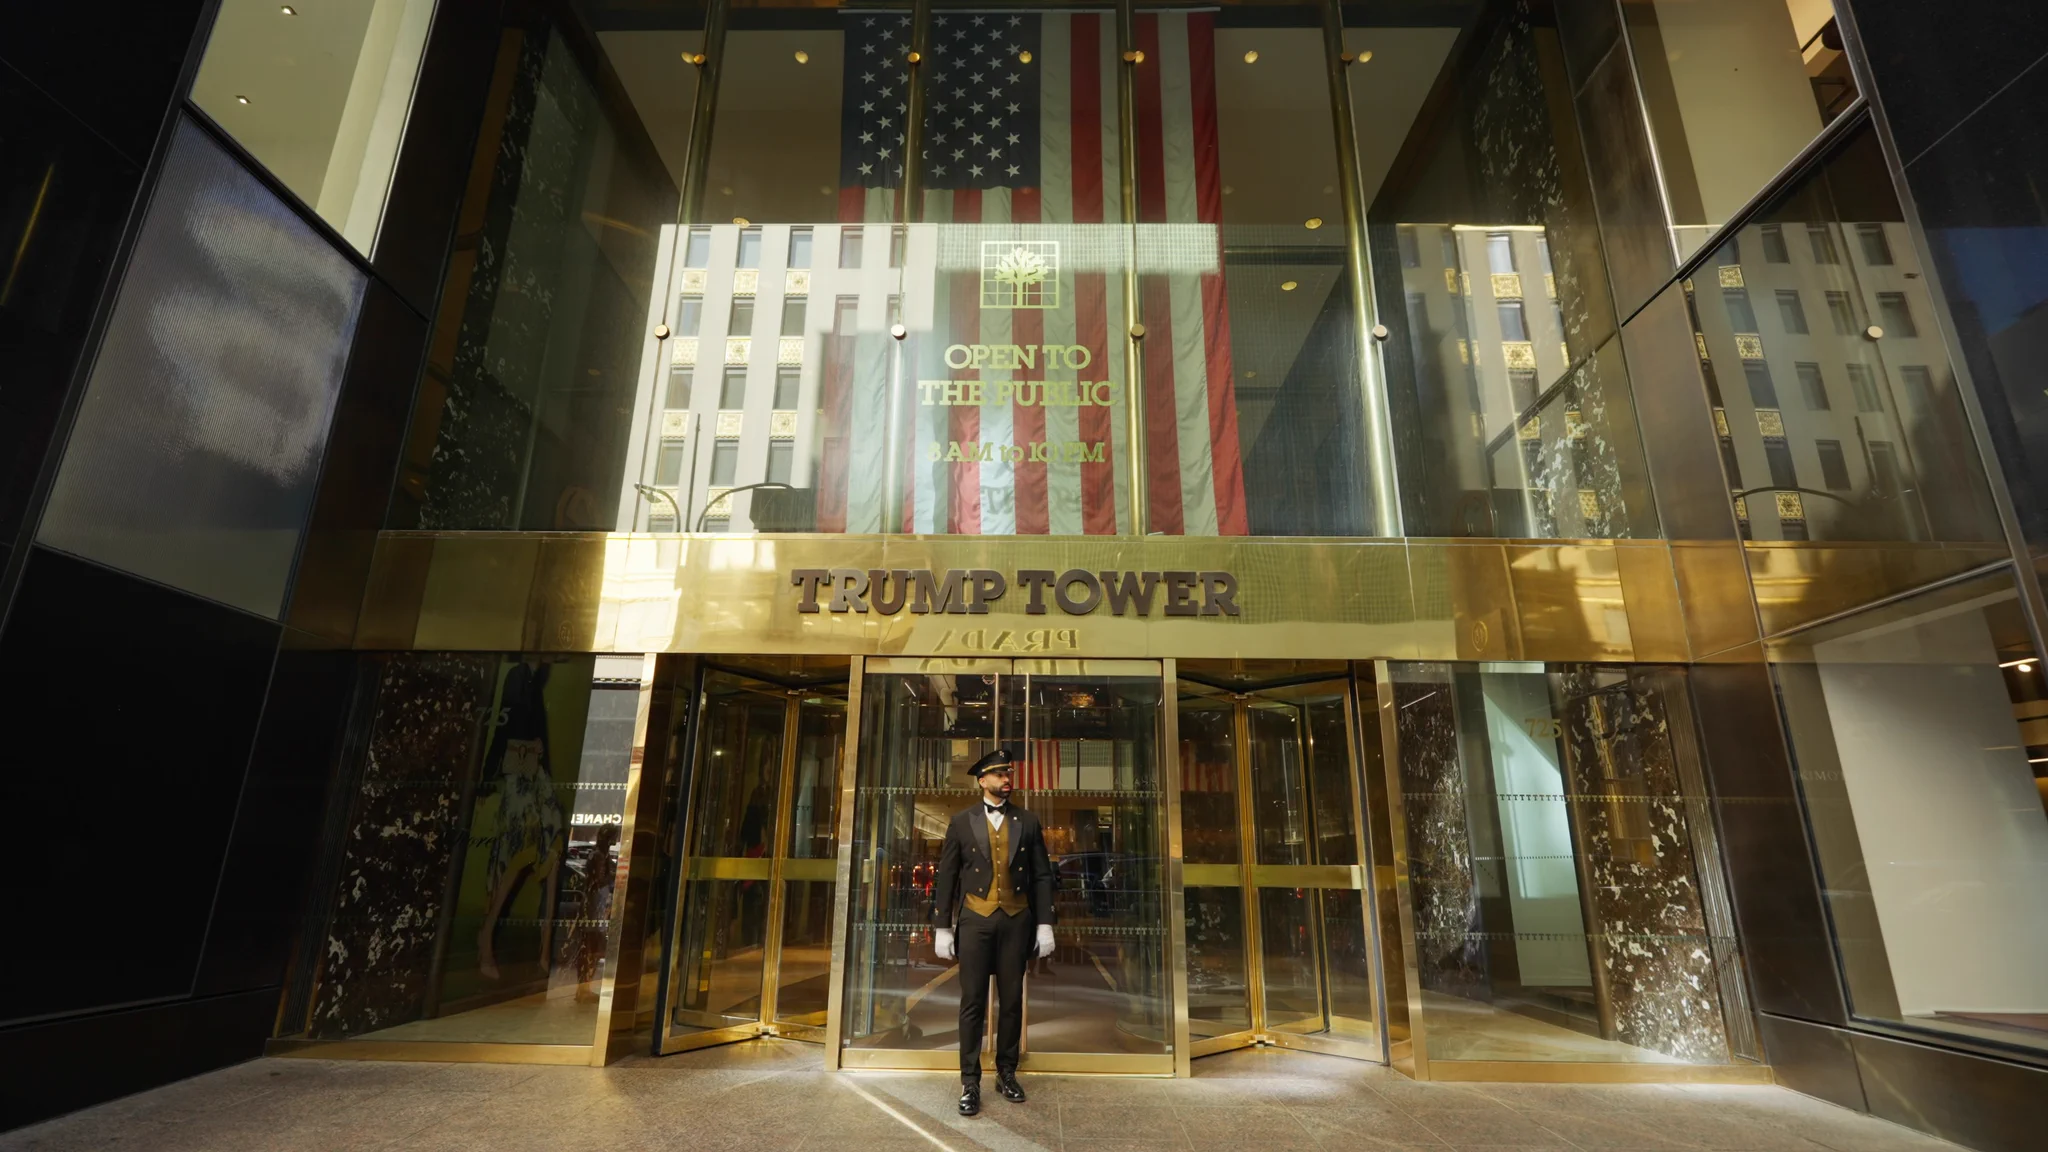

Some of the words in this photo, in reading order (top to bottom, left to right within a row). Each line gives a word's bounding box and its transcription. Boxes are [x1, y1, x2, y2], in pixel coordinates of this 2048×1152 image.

[944, 344, 1038, 370] OPEN
[1042, 344, 1092, 370] TO
[917, 380, 987, 406] THE
[993, 380, 1120, 406] PUBLIC
[999, 445, 1025, 462] to
[1028, 441, 1059, 463] 10
[1062, 441, 1106, 463] PM
[791, 568, 1007, 616] TRUMP
[1017, 568, 1240, 617] TOWER
[1525, 717, 1563, 739] 725
